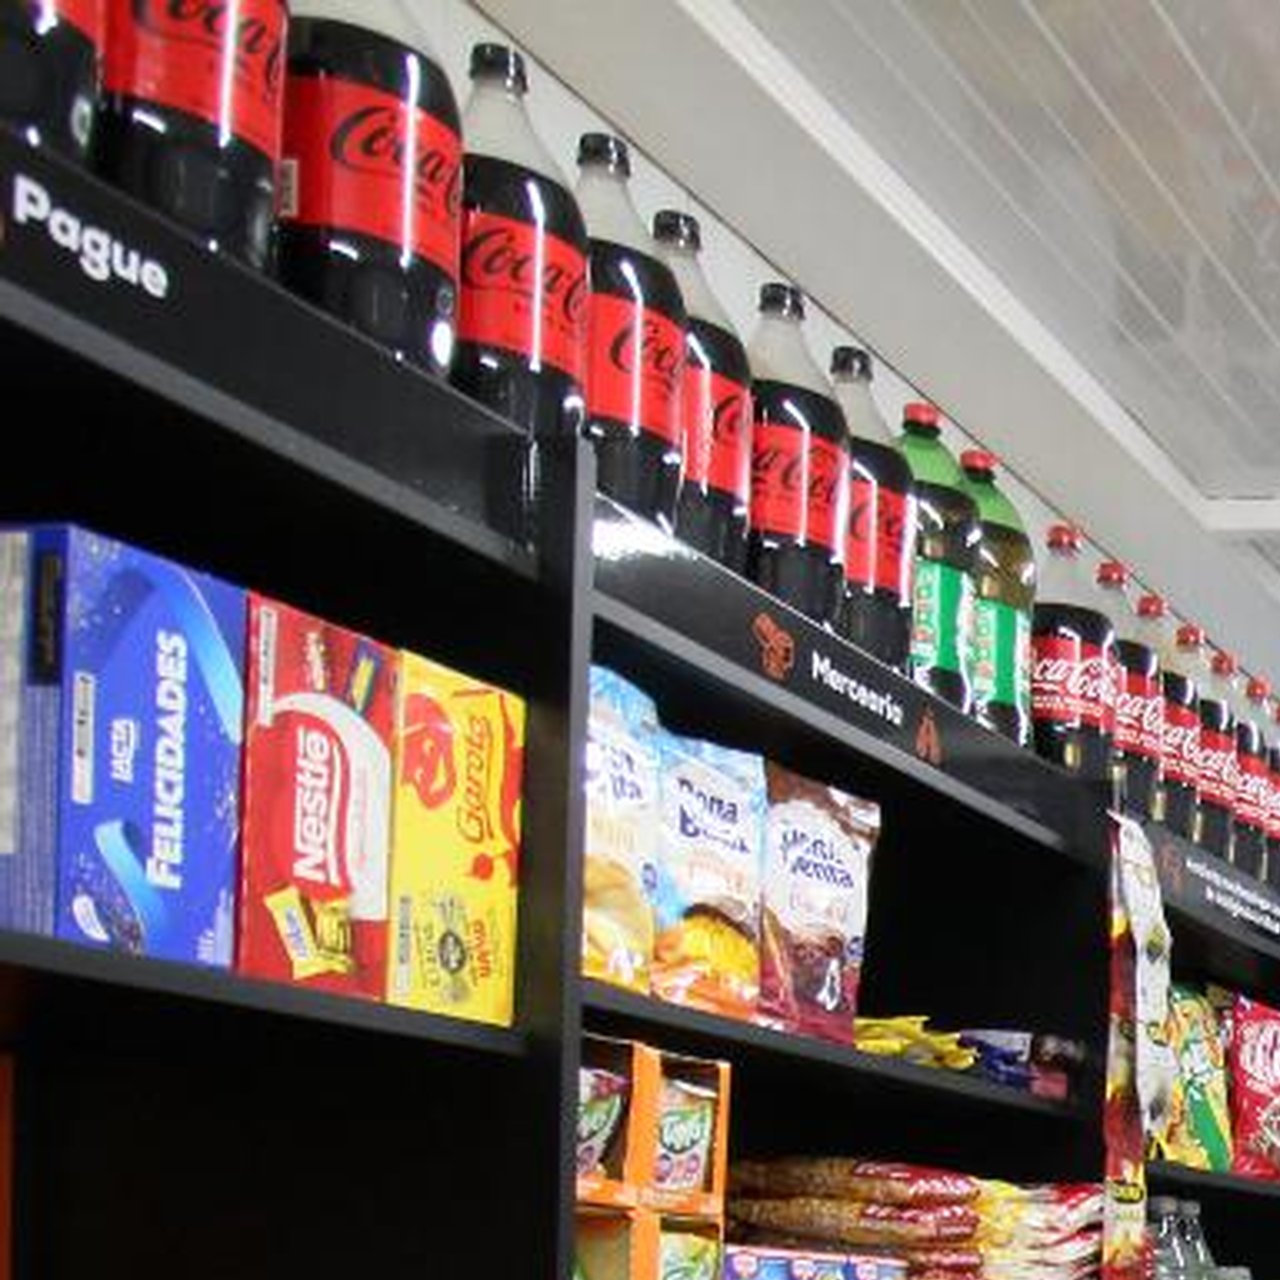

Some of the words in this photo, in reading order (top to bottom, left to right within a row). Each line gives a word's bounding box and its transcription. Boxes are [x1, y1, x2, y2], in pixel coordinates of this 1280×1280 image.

[14, 174, 168, 298] Pague
[811, 649, 904, 726] Mercearia
[146, 630, 189, 888] FELICIDADES
[456, 713, 493, 844] Garoto
